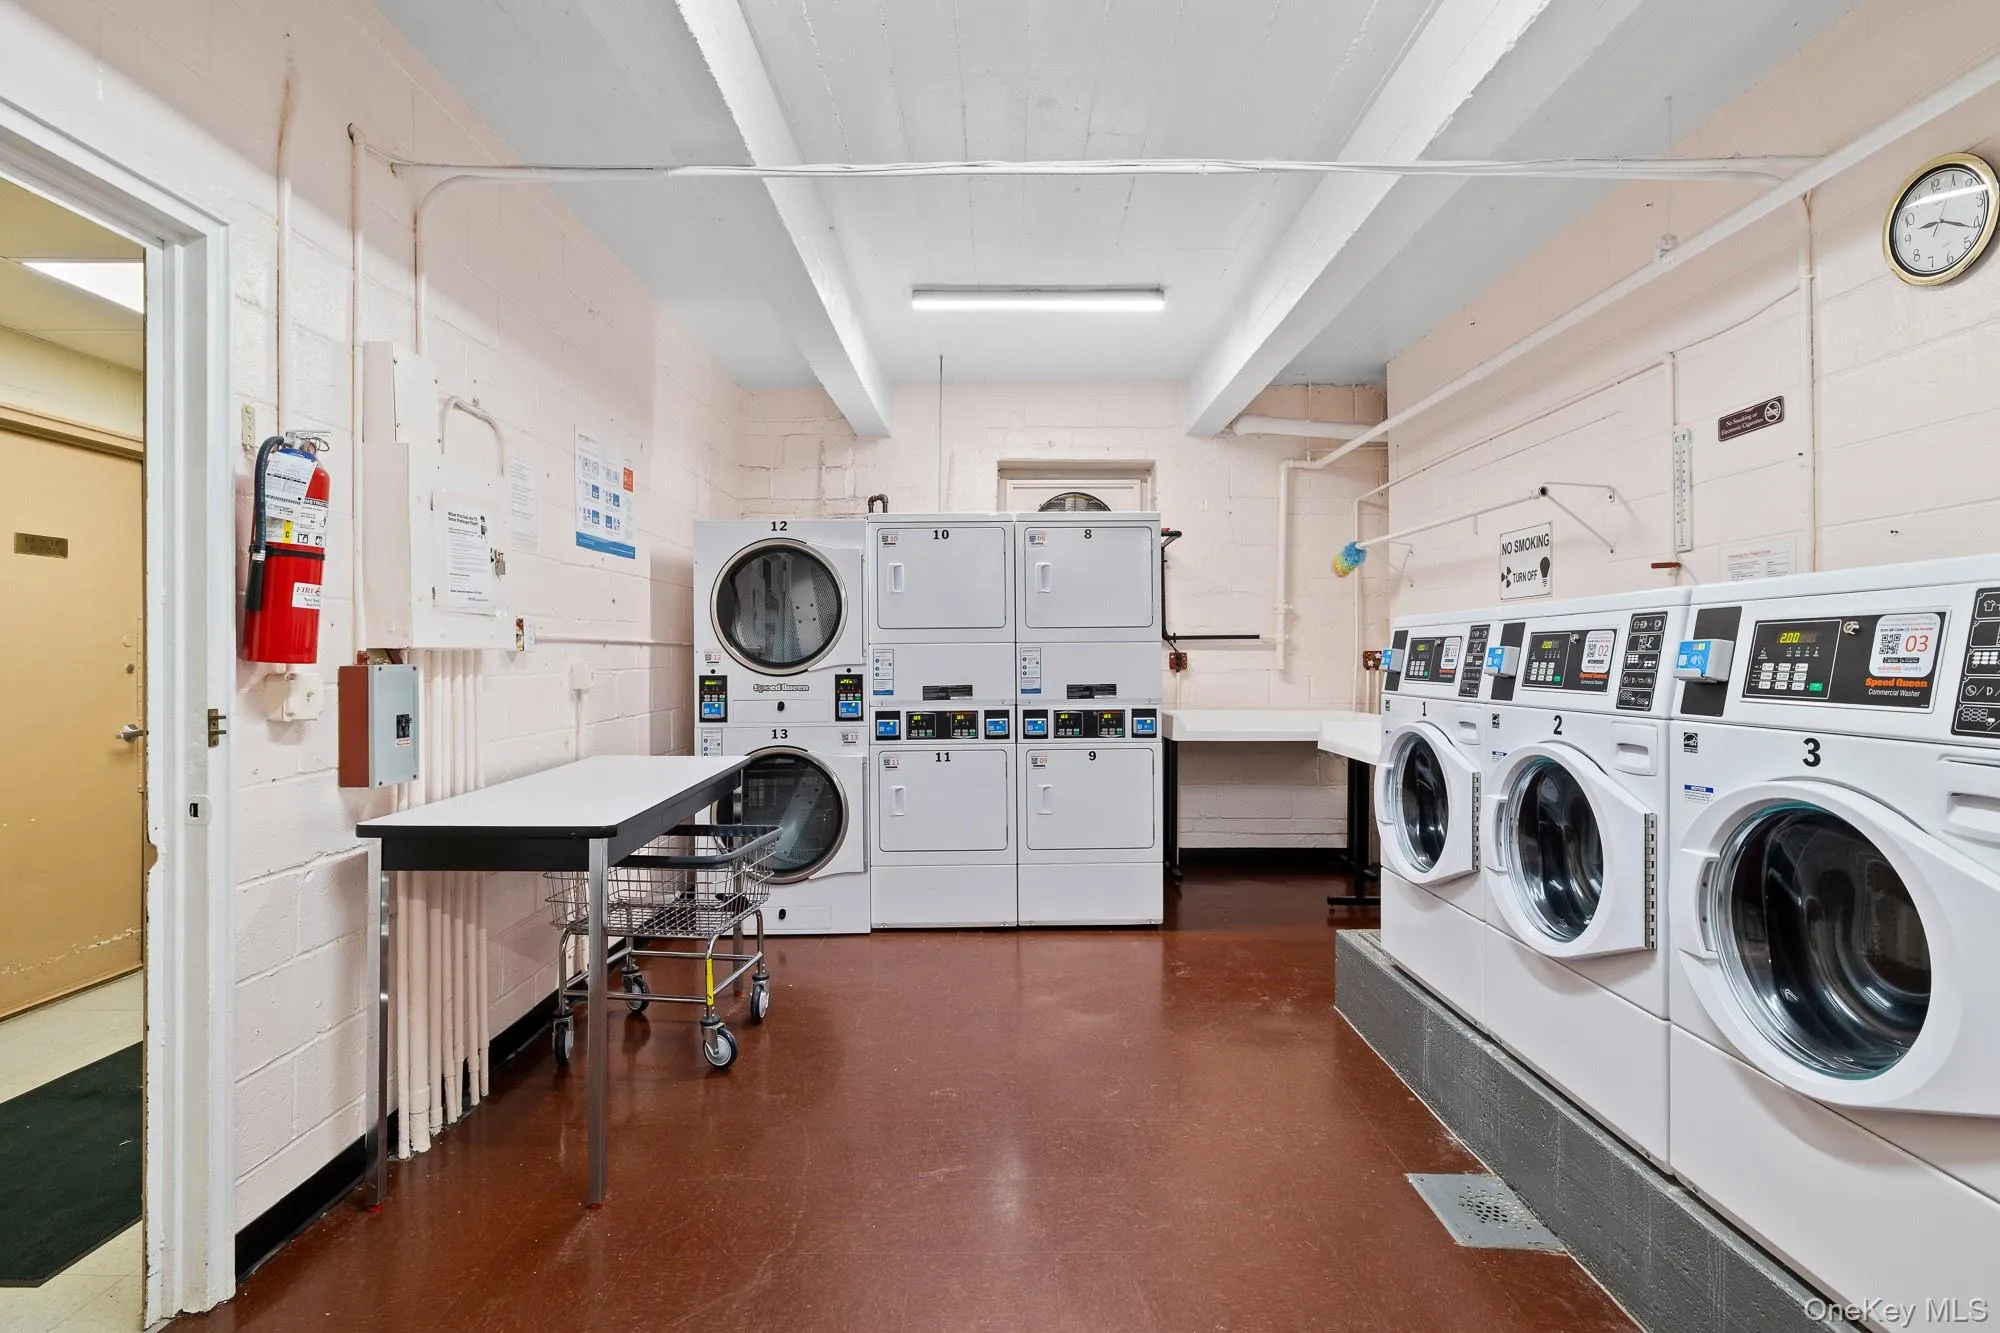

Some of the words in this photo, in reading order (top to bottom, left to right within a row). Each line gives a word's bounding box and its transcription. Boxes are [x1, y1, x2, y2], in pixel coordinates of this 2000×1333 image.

[1931, 179, 1940, 193] 12
[1976, 193, 1984, 207] 3
[1905, 212, 1915, 227] 10
[1974, 216, 1982, 228] 4
[1905, 234, 1911, 244] 9
[1964, 235, 1972, 249] 5
[1913, 249, 1920, 262] 8
[1947, 251, 1954, 264] 6
[1928, 256, 1934, 268] 7
[771, 521, 787, 531] 12
[933, 529, 949, 539] 10
[1084, 529, 1092, 539] 8
[1502, 541, 1512, 555] NO
[1513, 533, 1550, 553] SMOKING
[1512, 571, 1526, 583] TURN
[1527, 570, 1537, 581] OFF
[1905, 635, 1928, 653] 03
[1597, 645, 1608, 656] 02
[1865, 677, 1895, 687] Speed
[1896, 678, 1928, 688] Queen
[1868, 688, 1899, 696] Commercial
[1900, 689, 1920, 697] Washer
[1422, 702, 1427, 717] 1
[1553, 715, 1562, 735] 2
[772, 729, 788, 739] 13
[936, 752, 950, 762] 11
[1088, 751, 1096, 761] 9
[1803, 738, 1821, 767] 3
